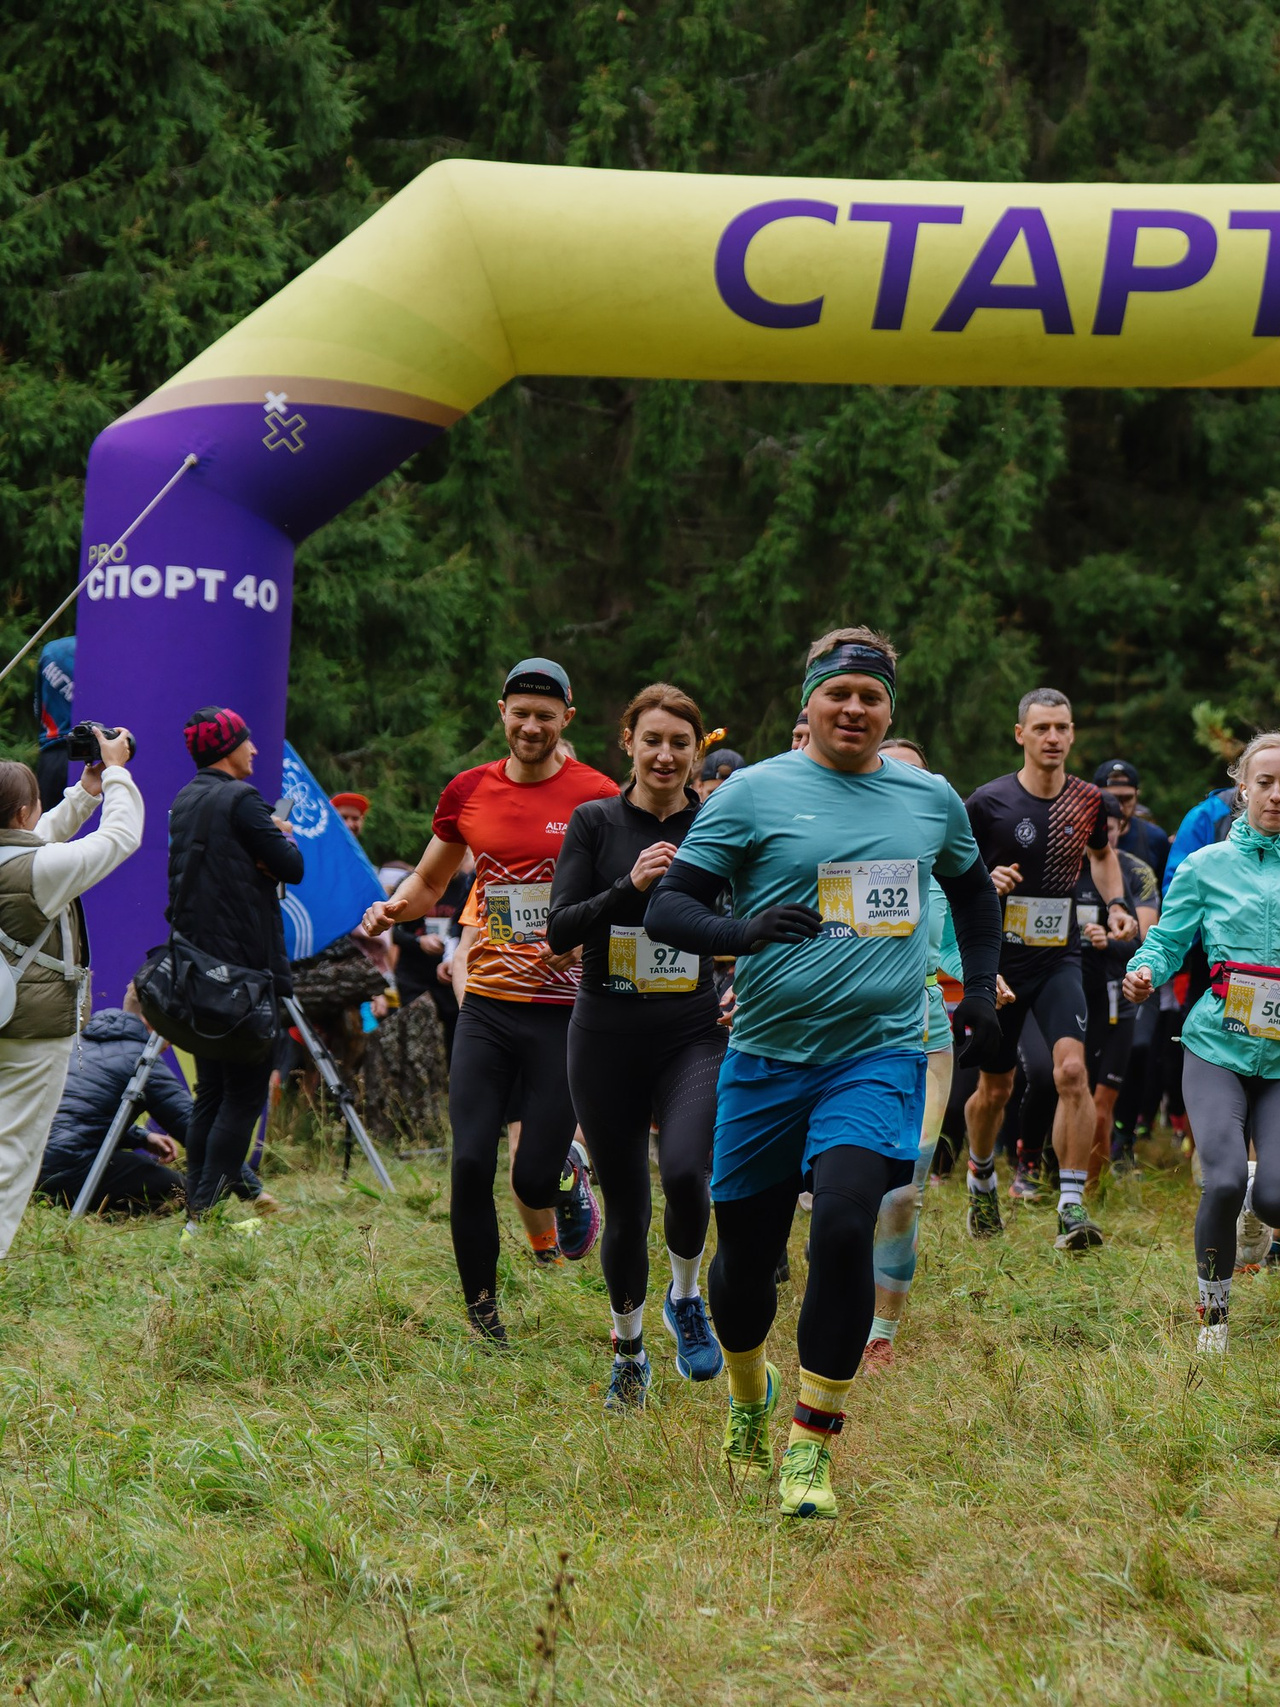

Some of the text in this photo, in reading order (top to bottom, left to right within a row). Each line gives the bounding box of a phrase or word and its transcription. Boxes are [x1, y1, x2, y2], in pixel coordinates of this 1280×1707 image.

[88, 541, 128, 566] PRO
[87, 564, 279, 613] СПОРТ 40
[866, 887, 909, 908] 432
[514, 907, 549, 921] 1010
[868, 908, 910, 919] ДМИТРИЙ
[1034, 915, 1063, 928] 637
[653, 947, 681, 965] 97
[649, 966, 687, 974] ТАТЬЯНА
